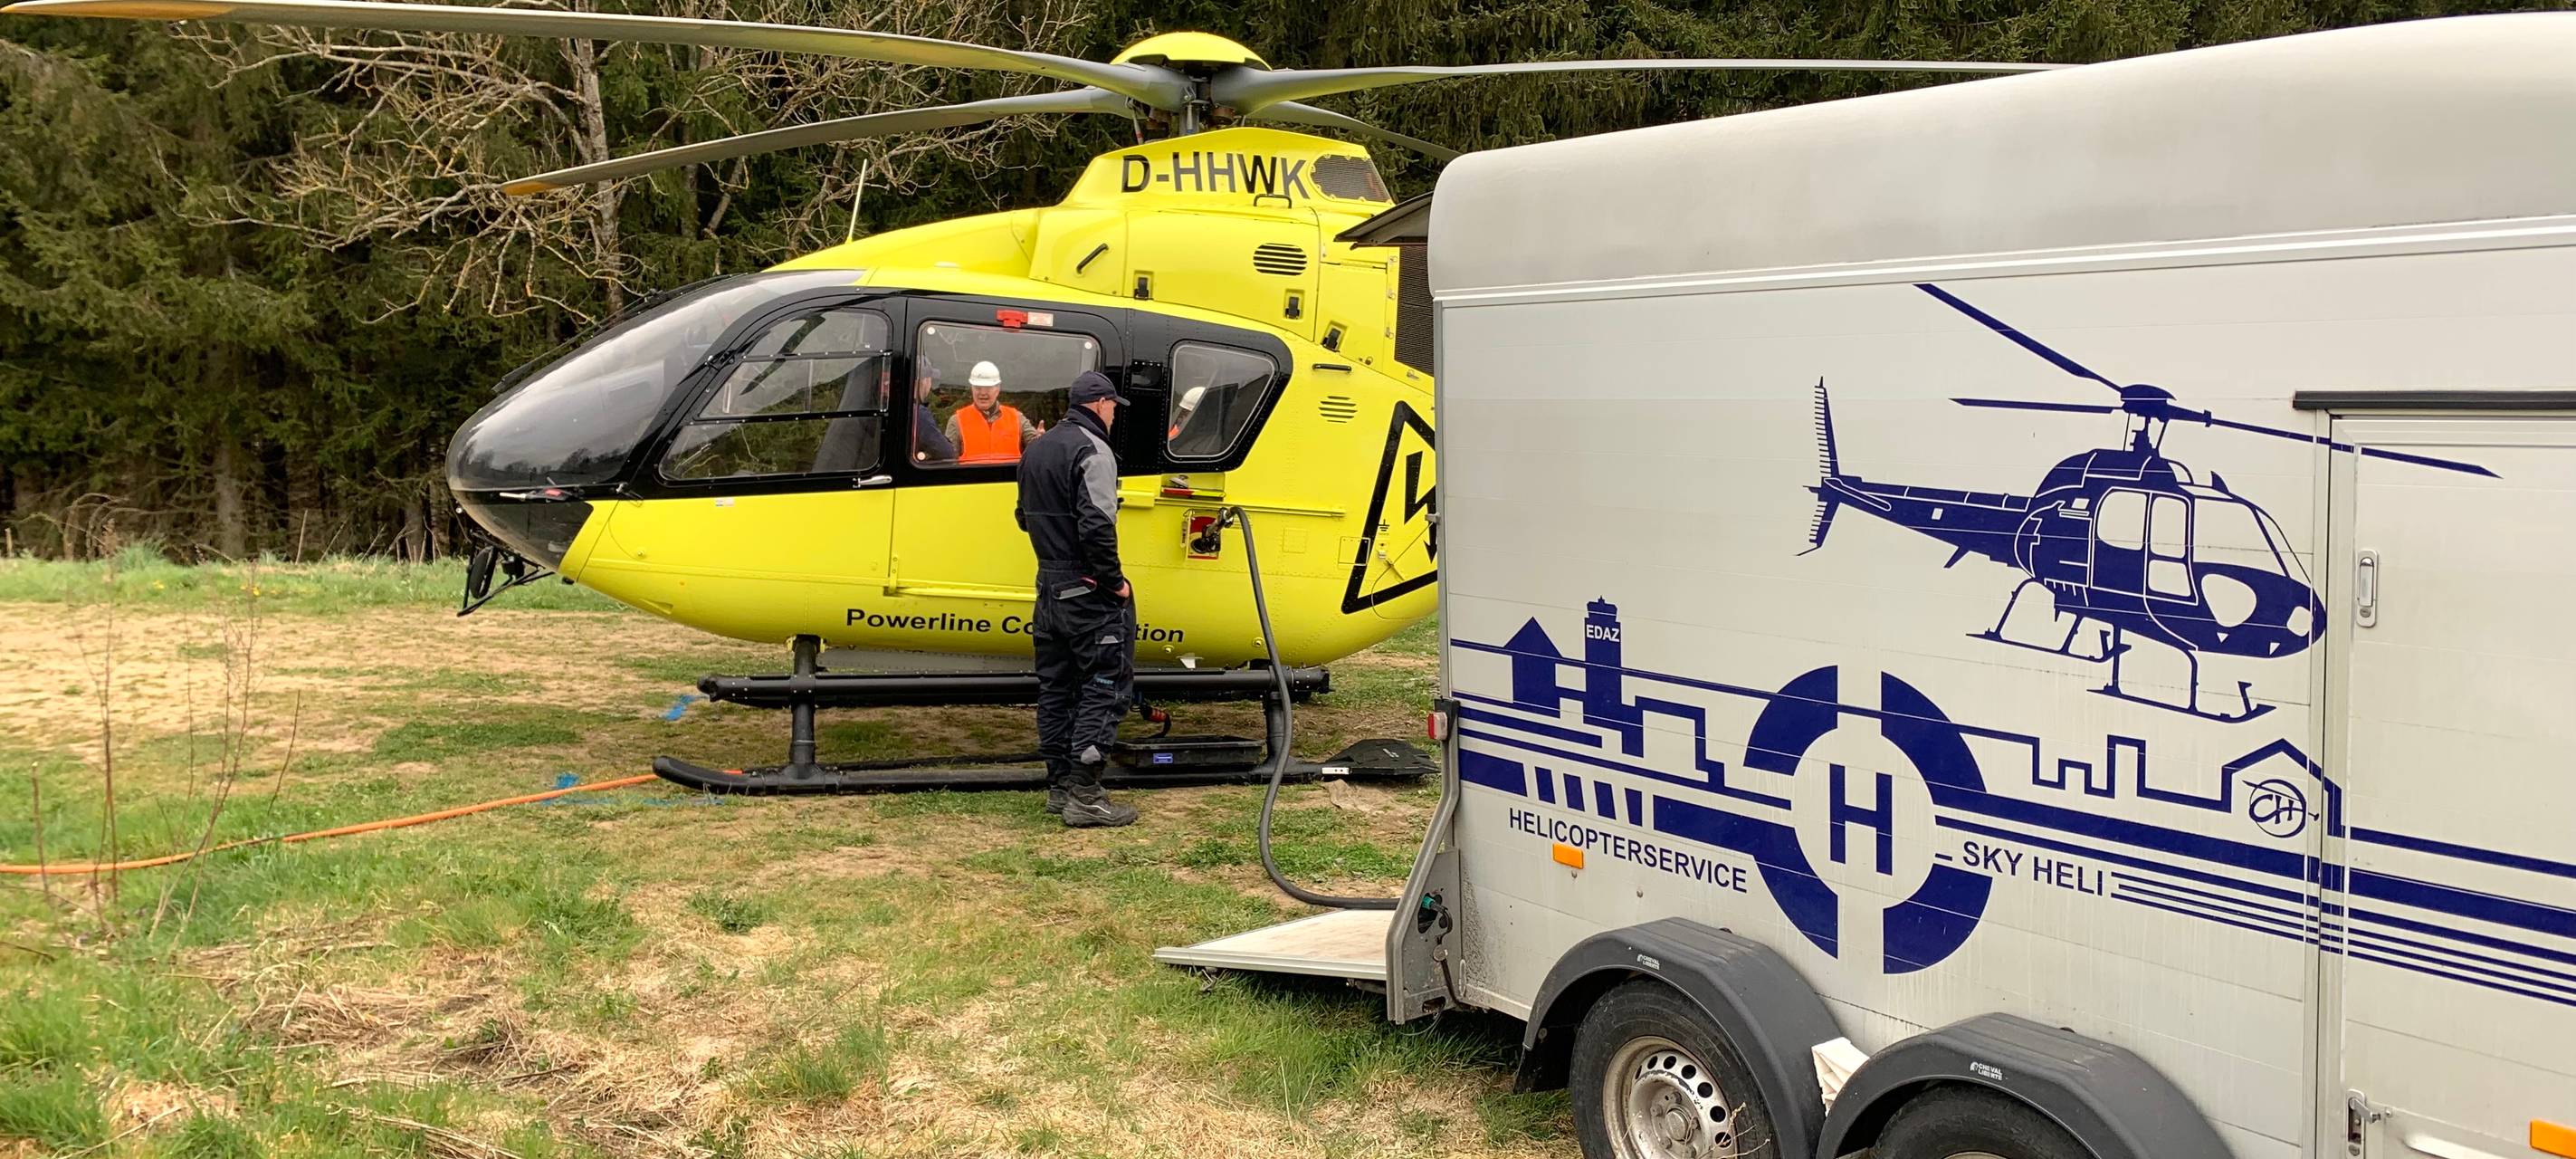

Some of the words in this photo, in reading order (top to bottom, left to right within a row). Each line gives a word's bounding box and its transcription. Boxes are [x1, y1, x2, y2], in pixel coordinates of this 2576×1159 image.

[1121, 150, 1310, 199] D-HHWK
[846, 608, 991, 633] Powerline
[1001, 616, 1184, 643] Cotion
[1586, 624, 1619, 642] EDAZ
[1828, 763, 1893, 876] H
[1509, 807, 1748, 894] HELICOPTERSERVICE
[1962, 840, 2024, 876] SKY
[2033, 856, 2104, 896] HELI
